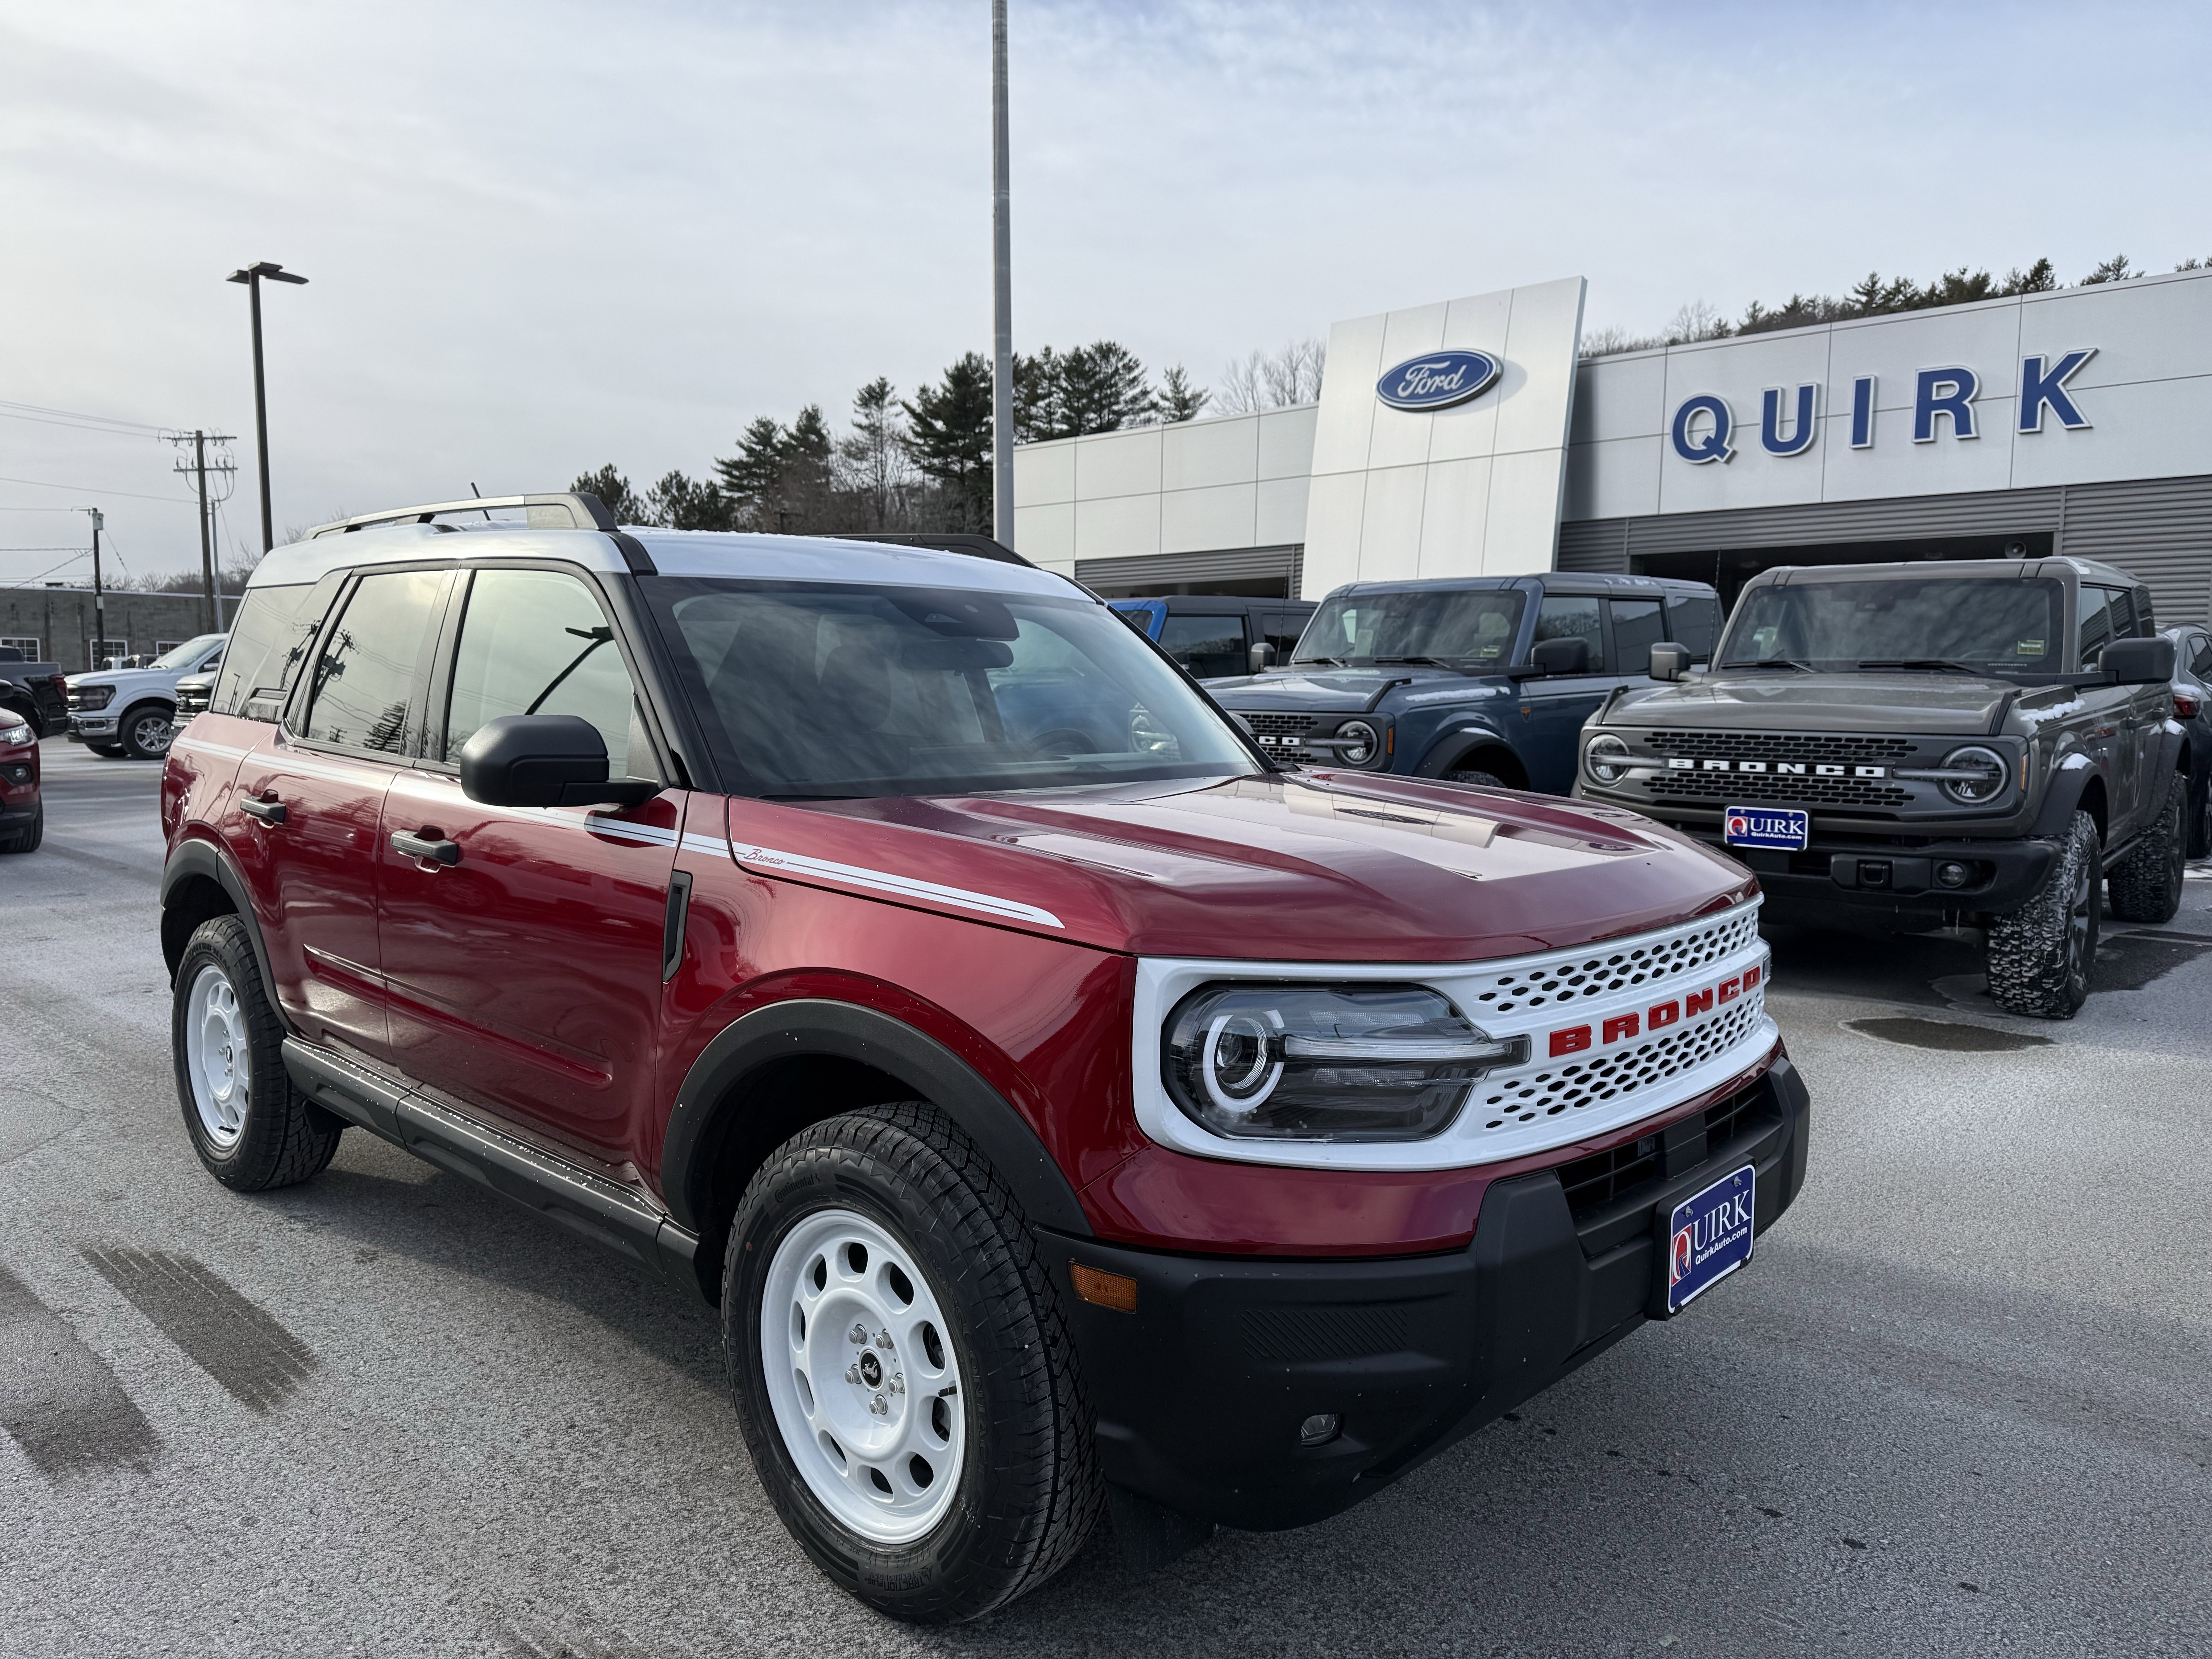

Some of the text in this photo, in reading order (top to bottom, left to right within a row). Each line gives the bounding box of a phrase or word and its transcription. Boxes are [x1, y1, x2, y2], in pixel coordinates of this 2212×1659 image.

[1397, 361, 1468, 397] Ford
[1671, 347, 2099, 465] QUIRK
[1669, 759, 1885, 778] BRONCO
[1728, 817, 1805, 836] QUIRK
[1751, 831, 1802, 840] QuirkAuto.com
[744, 848, 785, 865] Bronco
[1549, 964, 1760, 1058] BRONCO
[775, 1174, 816, 1203] Continental
[1673, 1190, 1751, 1279] QUIRK
[1695, 1226, 1748, 1265] QuirkAuto.com
